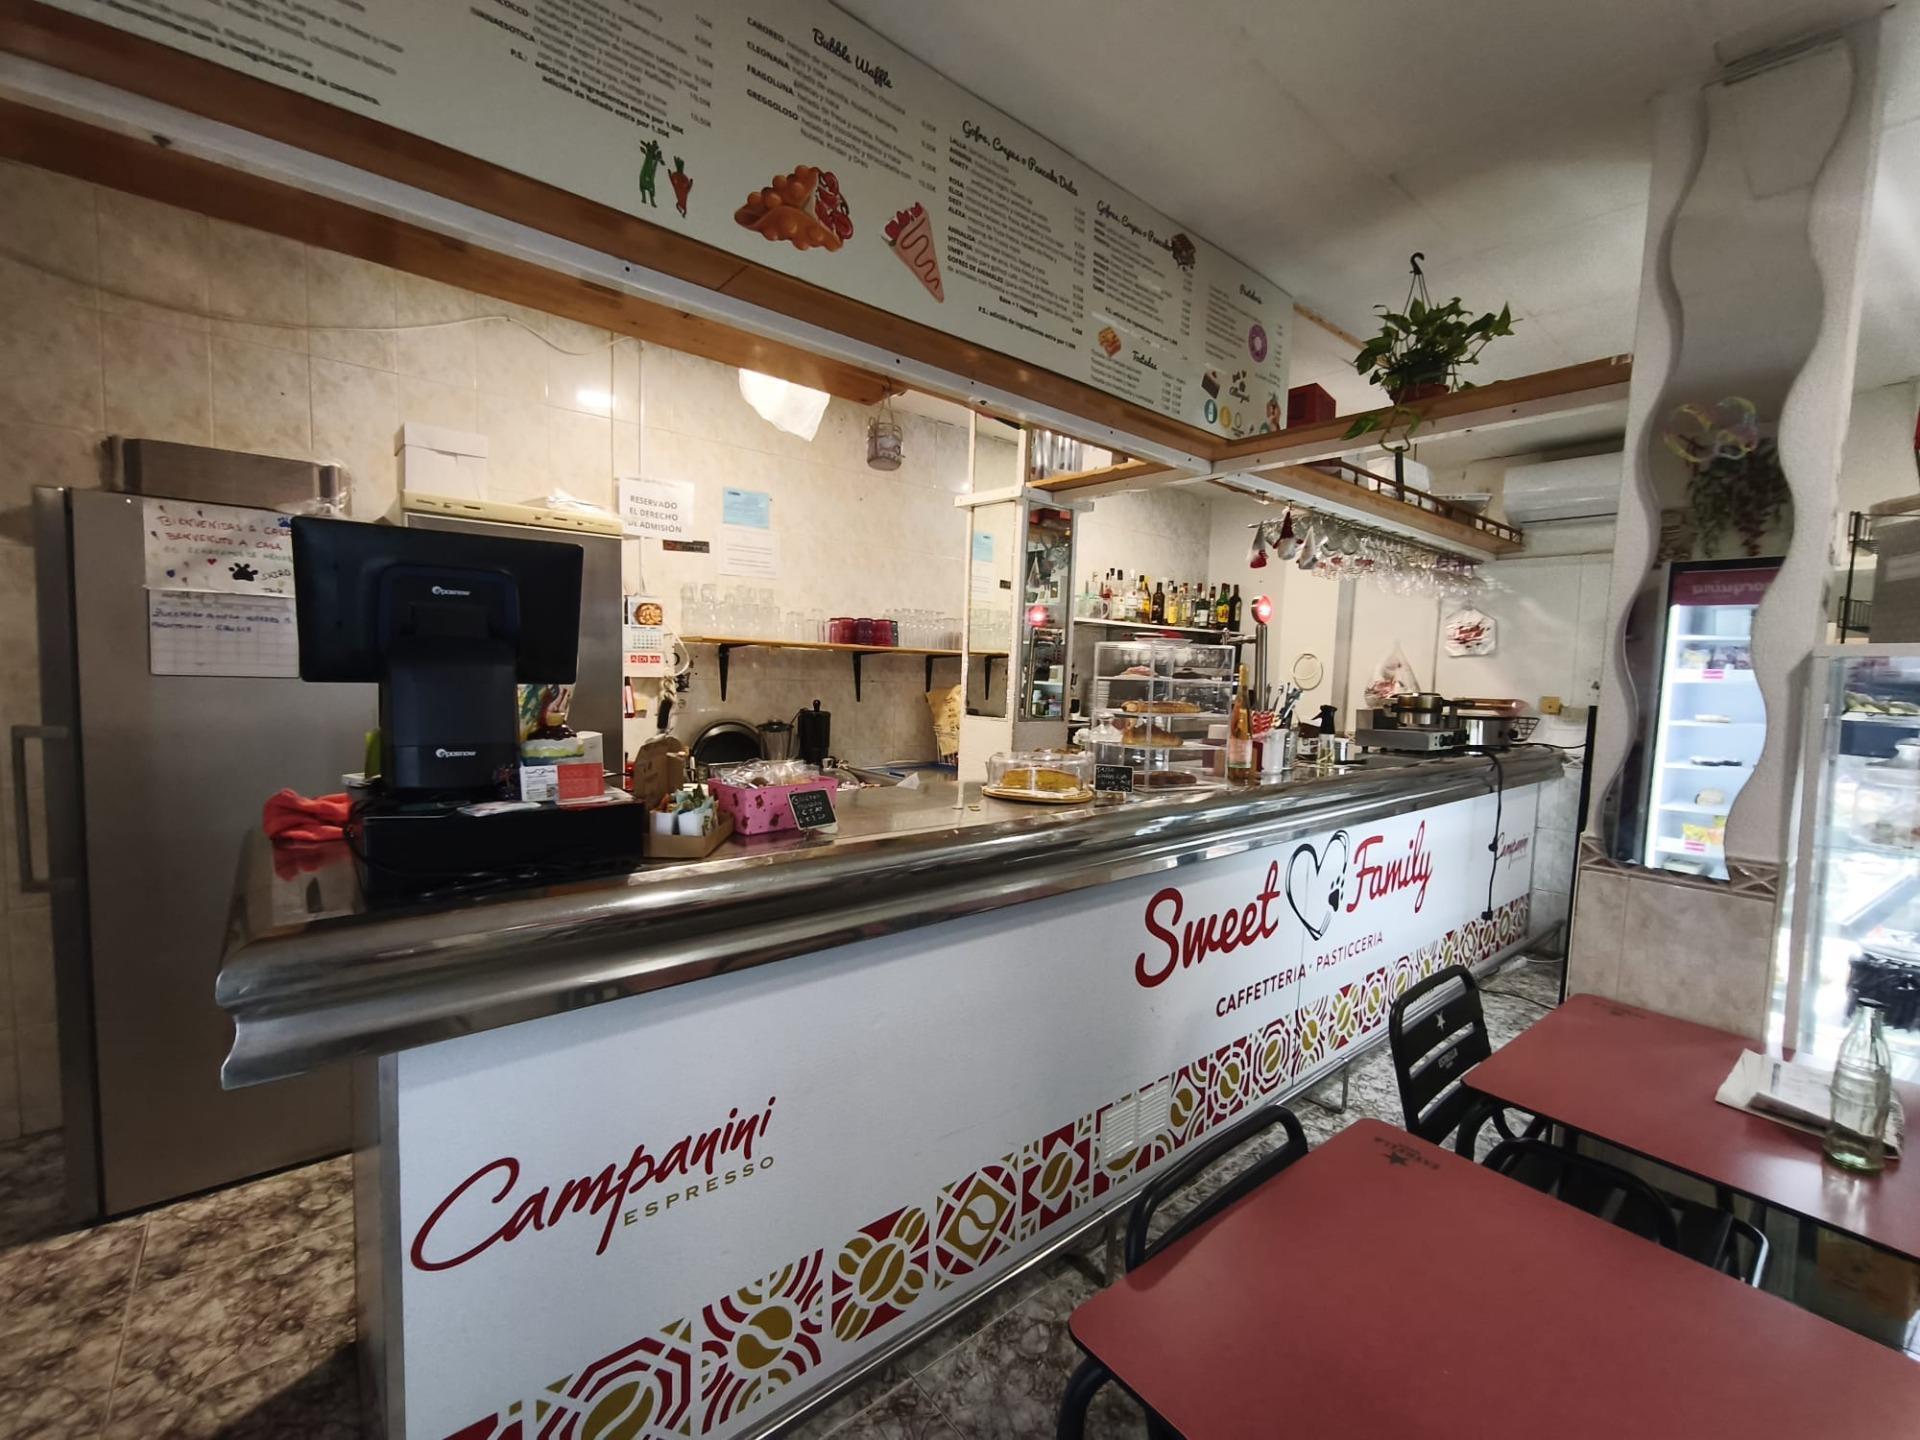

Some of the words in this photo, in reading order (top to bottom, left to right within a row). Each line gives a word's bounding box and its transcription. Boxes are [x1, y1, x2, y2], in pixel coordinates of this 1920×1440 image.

[629, 507, 638, 516] EL
[640, 509, 678, 521] DERECHO
[630, 495, 678, 510] RESERVADO
[1135, 860, 1281, 988] Sweet
[1346, 819, 1434, 914] Family
[1215, 963, 1306, 1018] CAFFETTERIA
[1315, 930, 1384, 971] PASTICCERIA
[410, 1096, 776, 1271] Campanini
[623, 1156, 775, 1226] ESPRESSO
